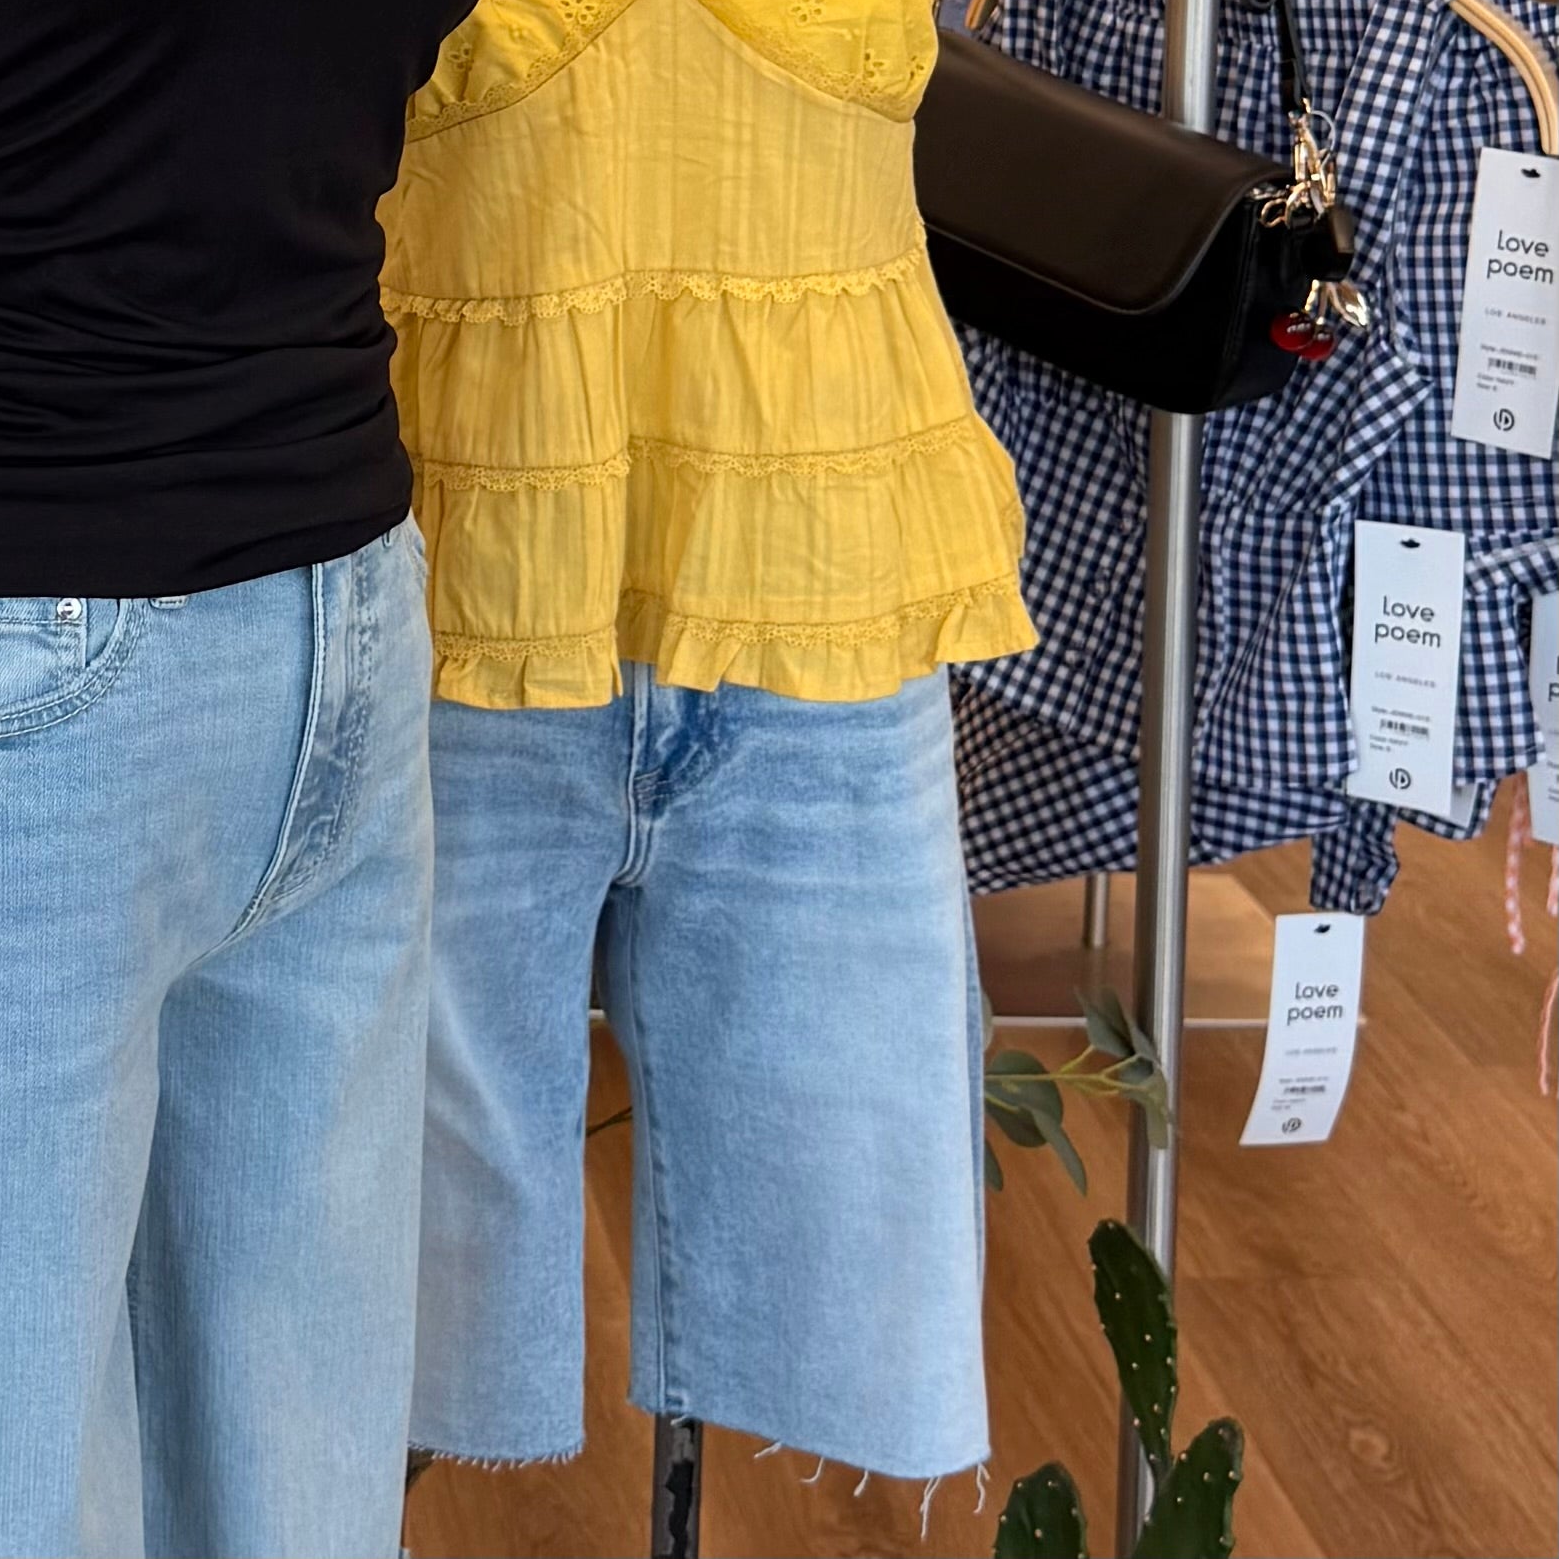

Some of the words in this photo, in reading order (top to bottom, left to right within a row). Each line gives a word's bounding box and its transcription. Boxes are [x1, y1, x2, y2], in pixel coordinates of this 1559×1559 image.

[1486, 258, 1554, 285] poem
[1374, 622, 1441, 648] poem
[1286, 1004, 1344, 1027] poem
